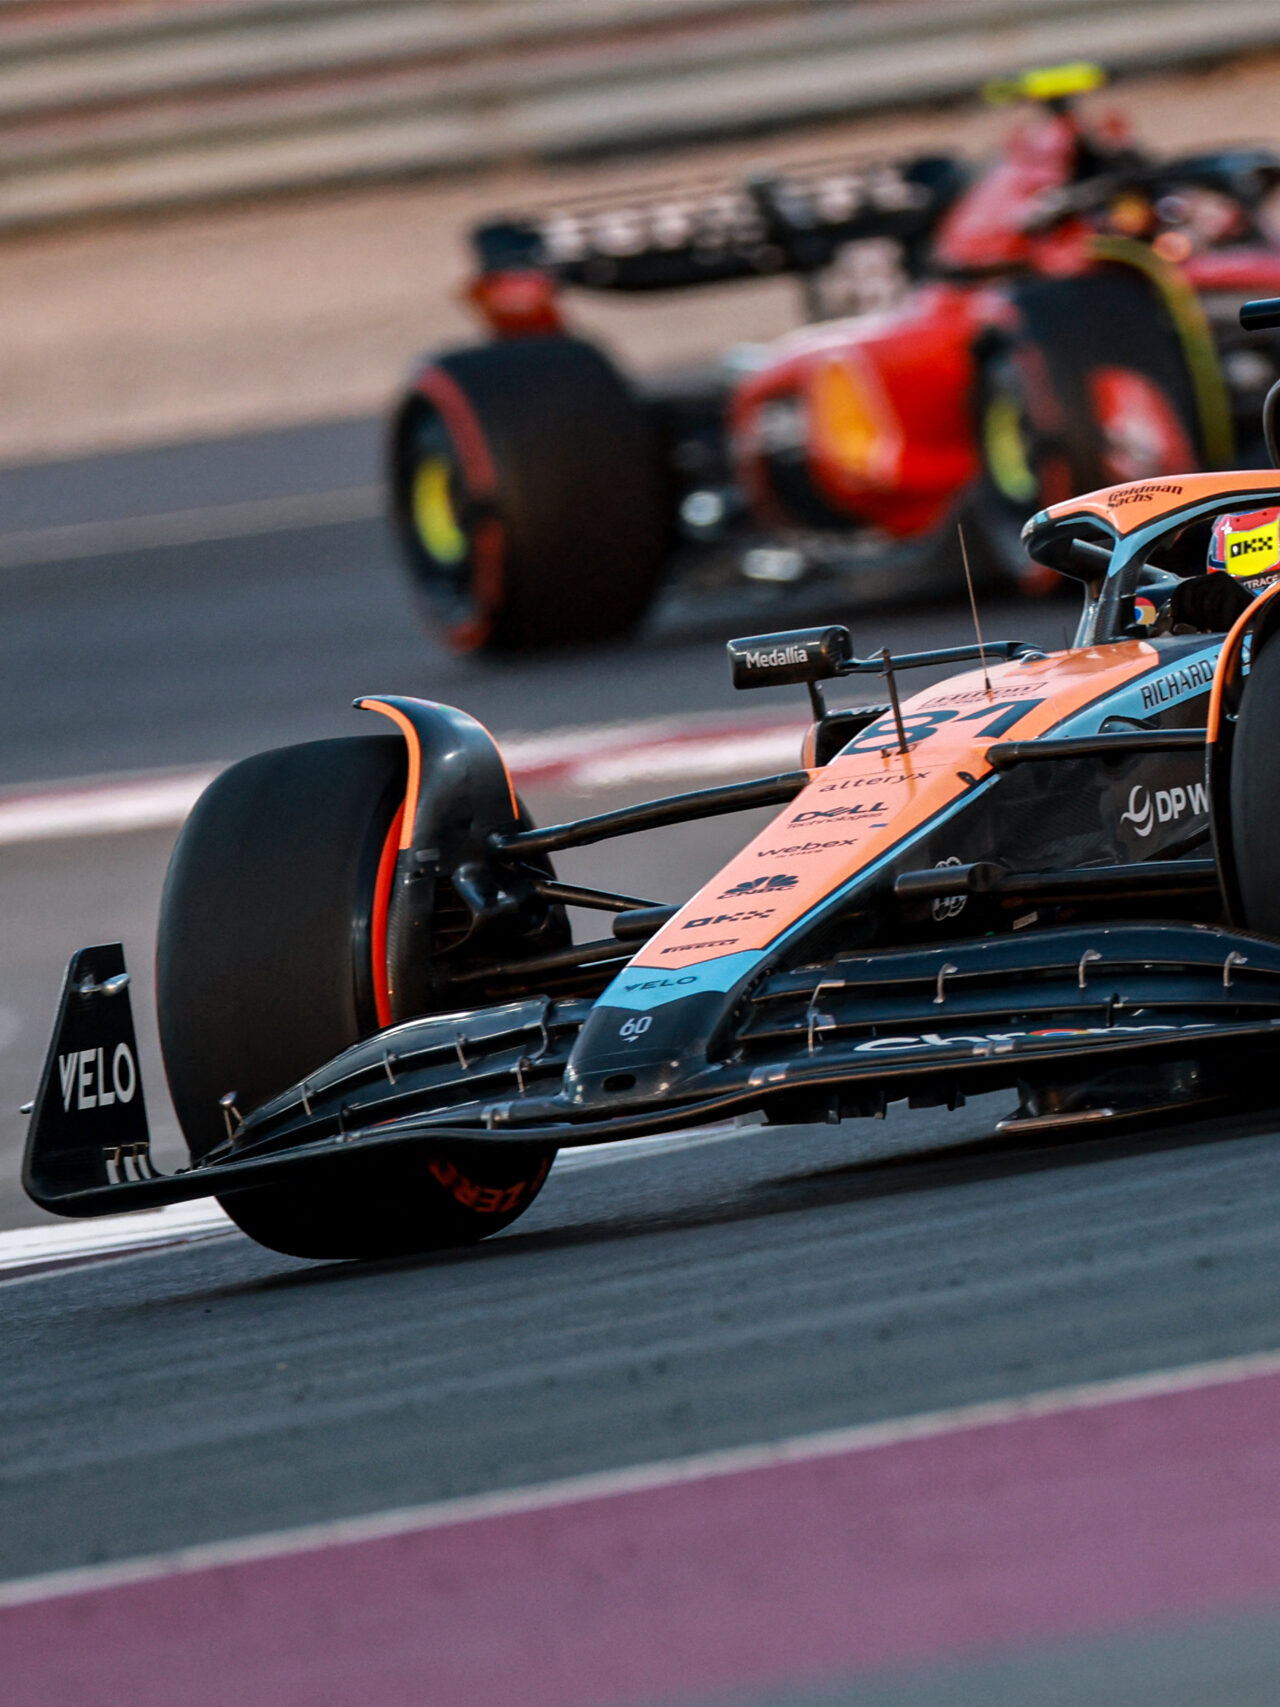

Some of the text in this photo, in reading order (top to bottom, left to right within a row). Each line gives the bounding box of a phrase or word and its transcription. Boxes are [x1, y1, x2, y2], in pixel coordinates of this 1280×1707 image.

[1108, 484, 1184, 502] Goldman
[1230, 536, 1273, 558] OKX
[1243, 574, 1280, 589] TRACE
[745, 644, 809, 669] Medallia
[1140, 659, 1214, 710] RICHARD
[840, 698, 1048, 756] 81
[819, 771, 932, 793] alteryx
[791, 801, 889, 824] DELL
[1155, 787, 1187, 823] DP
[757, 837, 860, 858] webex
[681, 908, 776, 930] OKX
[659, 938, 740, 955] PIRELLI
[624, 975, 698, 993] VELO
[618, 1015, 653, 1036] 60
[58, 1042, 136, 1113] VELO
